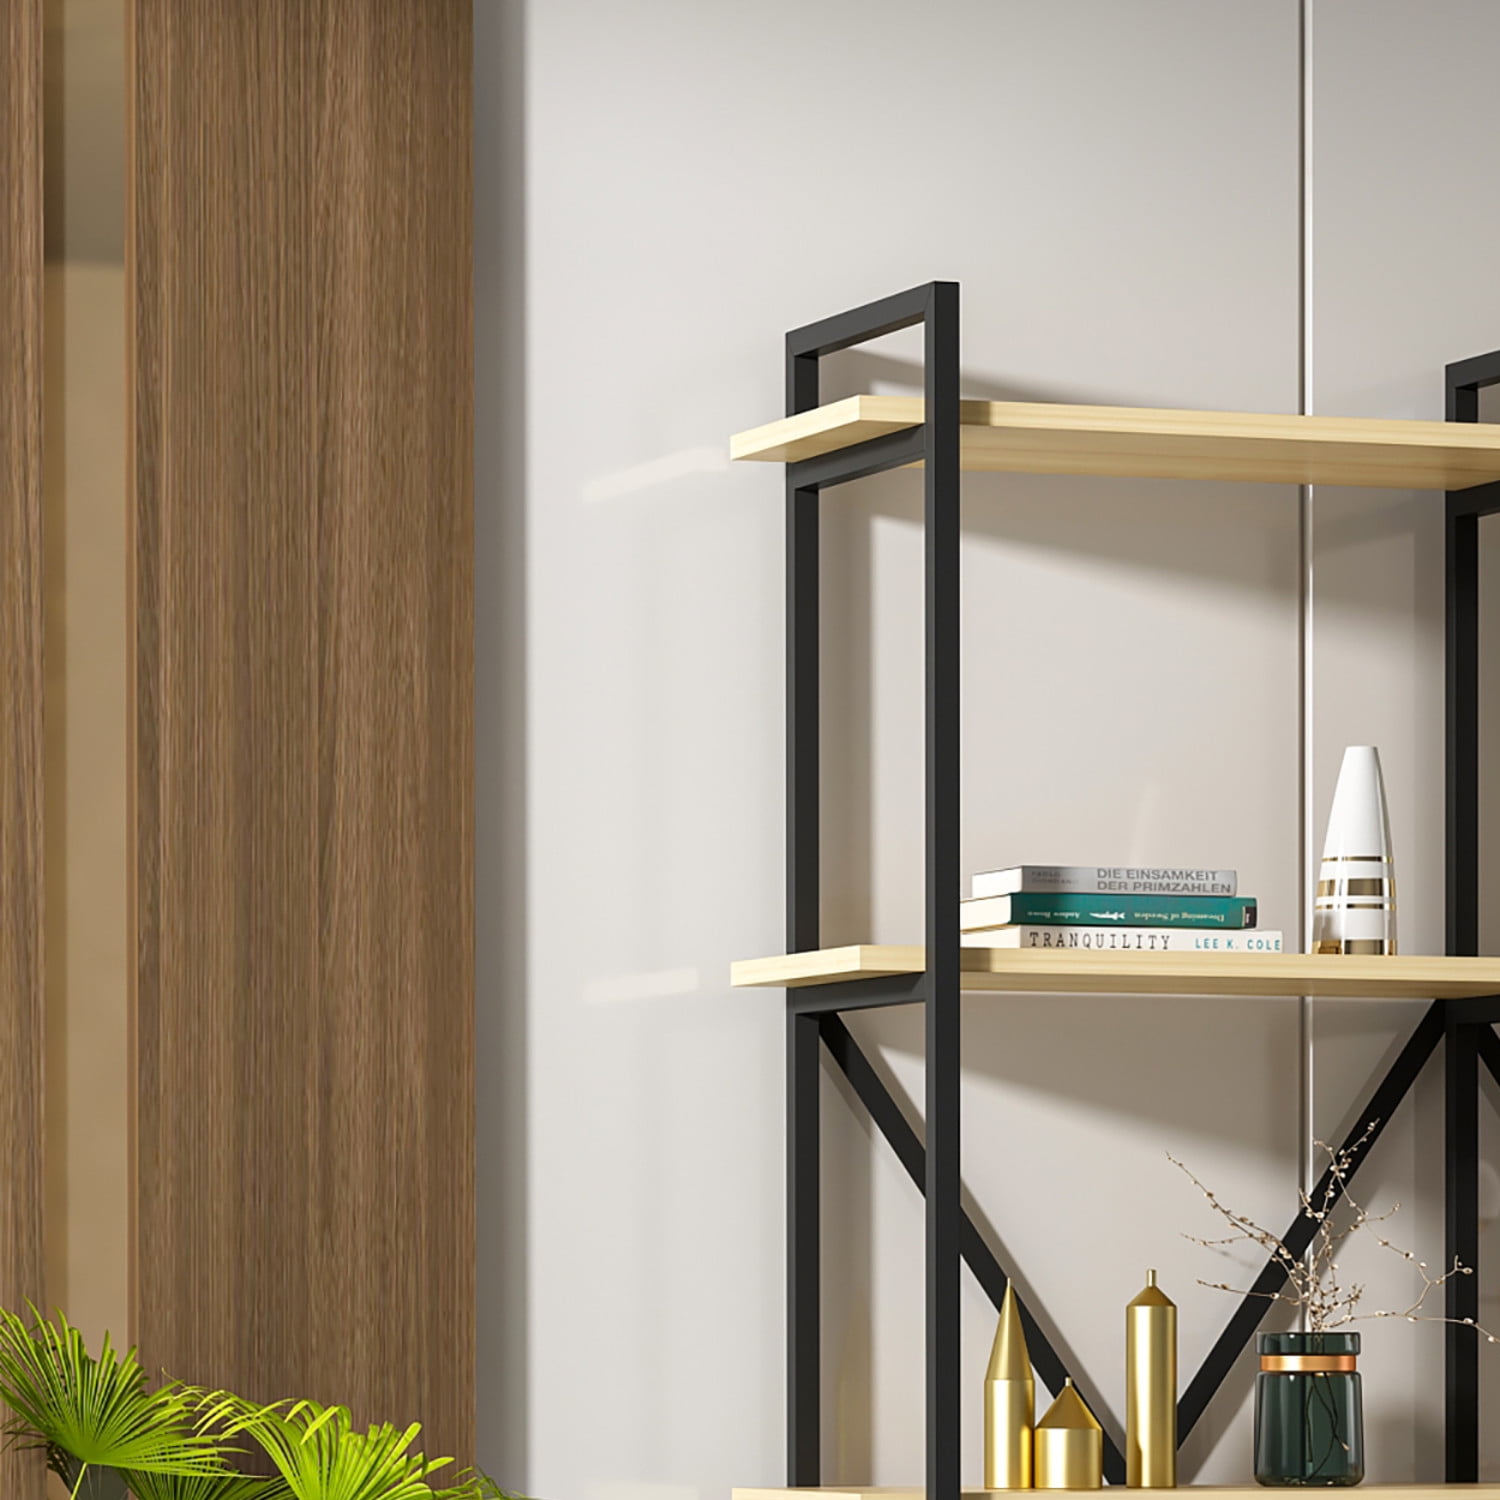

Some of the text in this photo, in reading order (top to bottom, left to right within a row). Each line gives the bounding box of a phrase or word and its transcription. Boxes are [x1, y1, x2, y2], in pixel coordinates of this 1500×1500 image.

[1097, 867, 1218, 882] DIE EINSAMKEIT
[1097, 880, 1232, 894] DER PRIMZAHLEN
[1170, 912, 1179, 922] of
[1028, 931, 1170, 950] TRANQUILITY
[1194, 938, 1282, 951] LEE K. COLE
